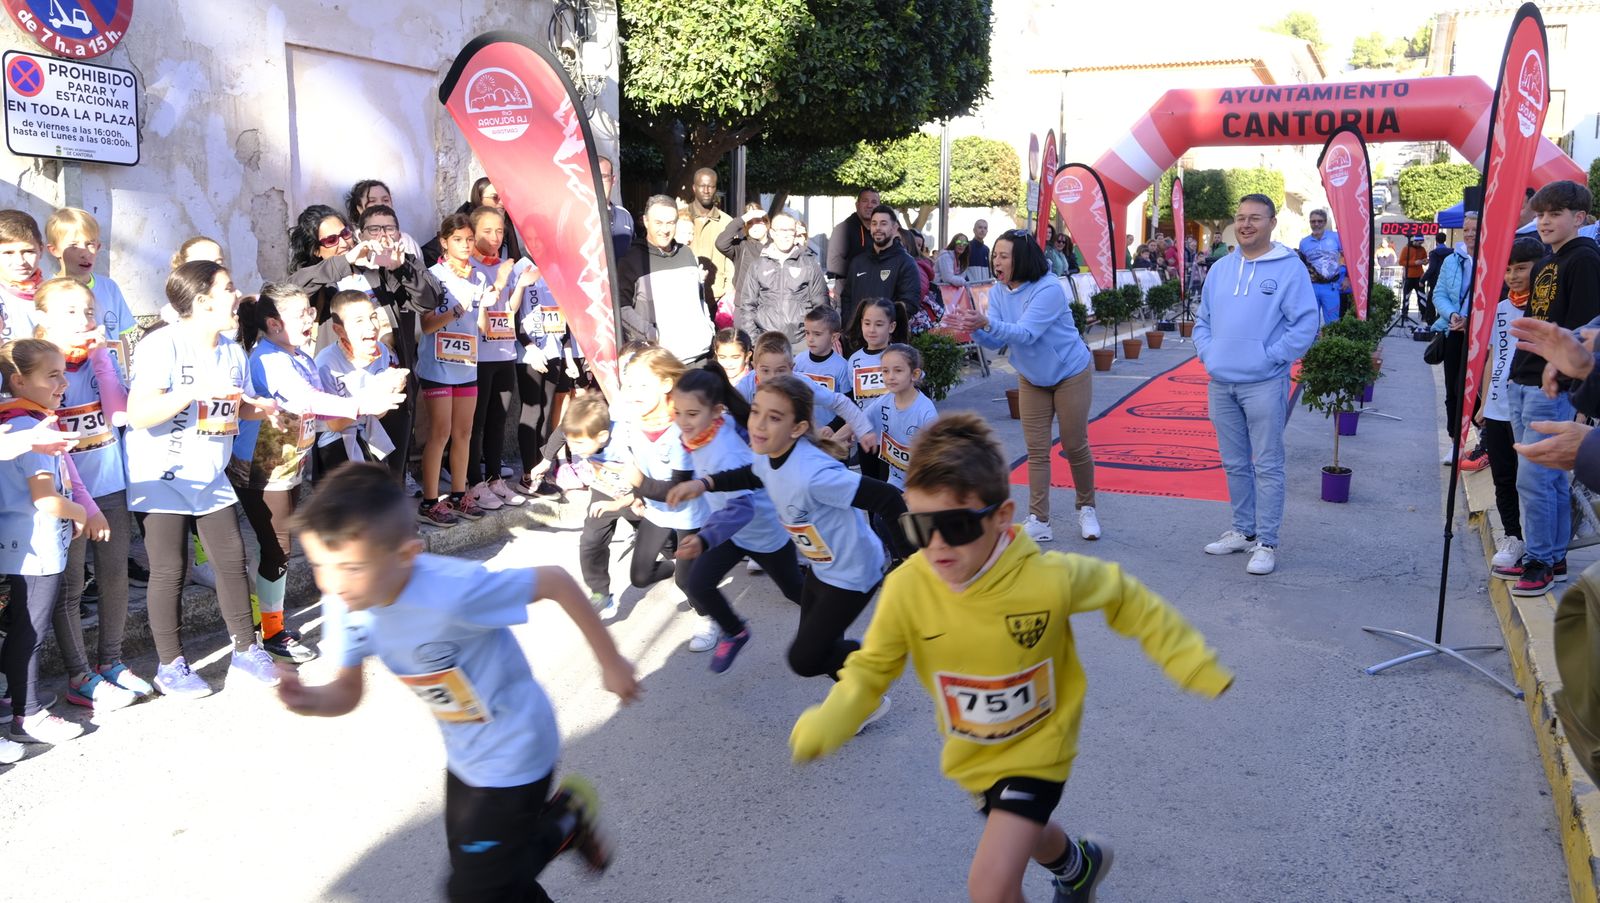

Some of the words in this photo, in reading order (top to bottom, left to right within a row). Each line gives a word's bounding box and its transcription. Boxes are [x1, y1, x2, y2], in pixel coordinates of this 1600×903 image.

[18, 10, 37, 32] de
[39, 29, 53, 43] 7
[55, 38, 70, 54] h.
[75, 45, 86, 56] a
[89, 36, 108, 54] 15
[105, 27, 122, 44] h.
[48, 63, 134, 88] PROHIBIDO
[68, 82, 107, 97] PARAR
[110, 88, 117, 97] Y
[1219, 82, 1409, 104] AYUNTAMIENTO
[56, 91, 129, 110] ESTACIONAR
[8, 100, 26, 112] EN
[31, 103, 70, 119] TODA
[74, 109, 91, 121] LA
[95, 112, 135, 127] PLAZA
[1222, 107, 1400, 138] CANTORIA
[13, 127, 38, 137] hasta
[41, 130, 49, 138] el
[51, 131, 77, 141] Lunes
[87, 135, 98, 144] las
[100, 136, 133, 148] 08:00h.
[22, 119, 34, 128] de
[36, 121, 70, 133] Viernes
[80, 126, 92, 135] las
[93, 128, 124, 139] 16:00h.
[490, 318, 509, 328] 742
[1497, 312, 1508, 328] LA
[443, 339, 470, 351] 745
[211, 402, 237, 417] 704
[67, 411, 105, 432] 730
[886, 441, 910, 461] 720
[958, 685, 1030, 713] 751
